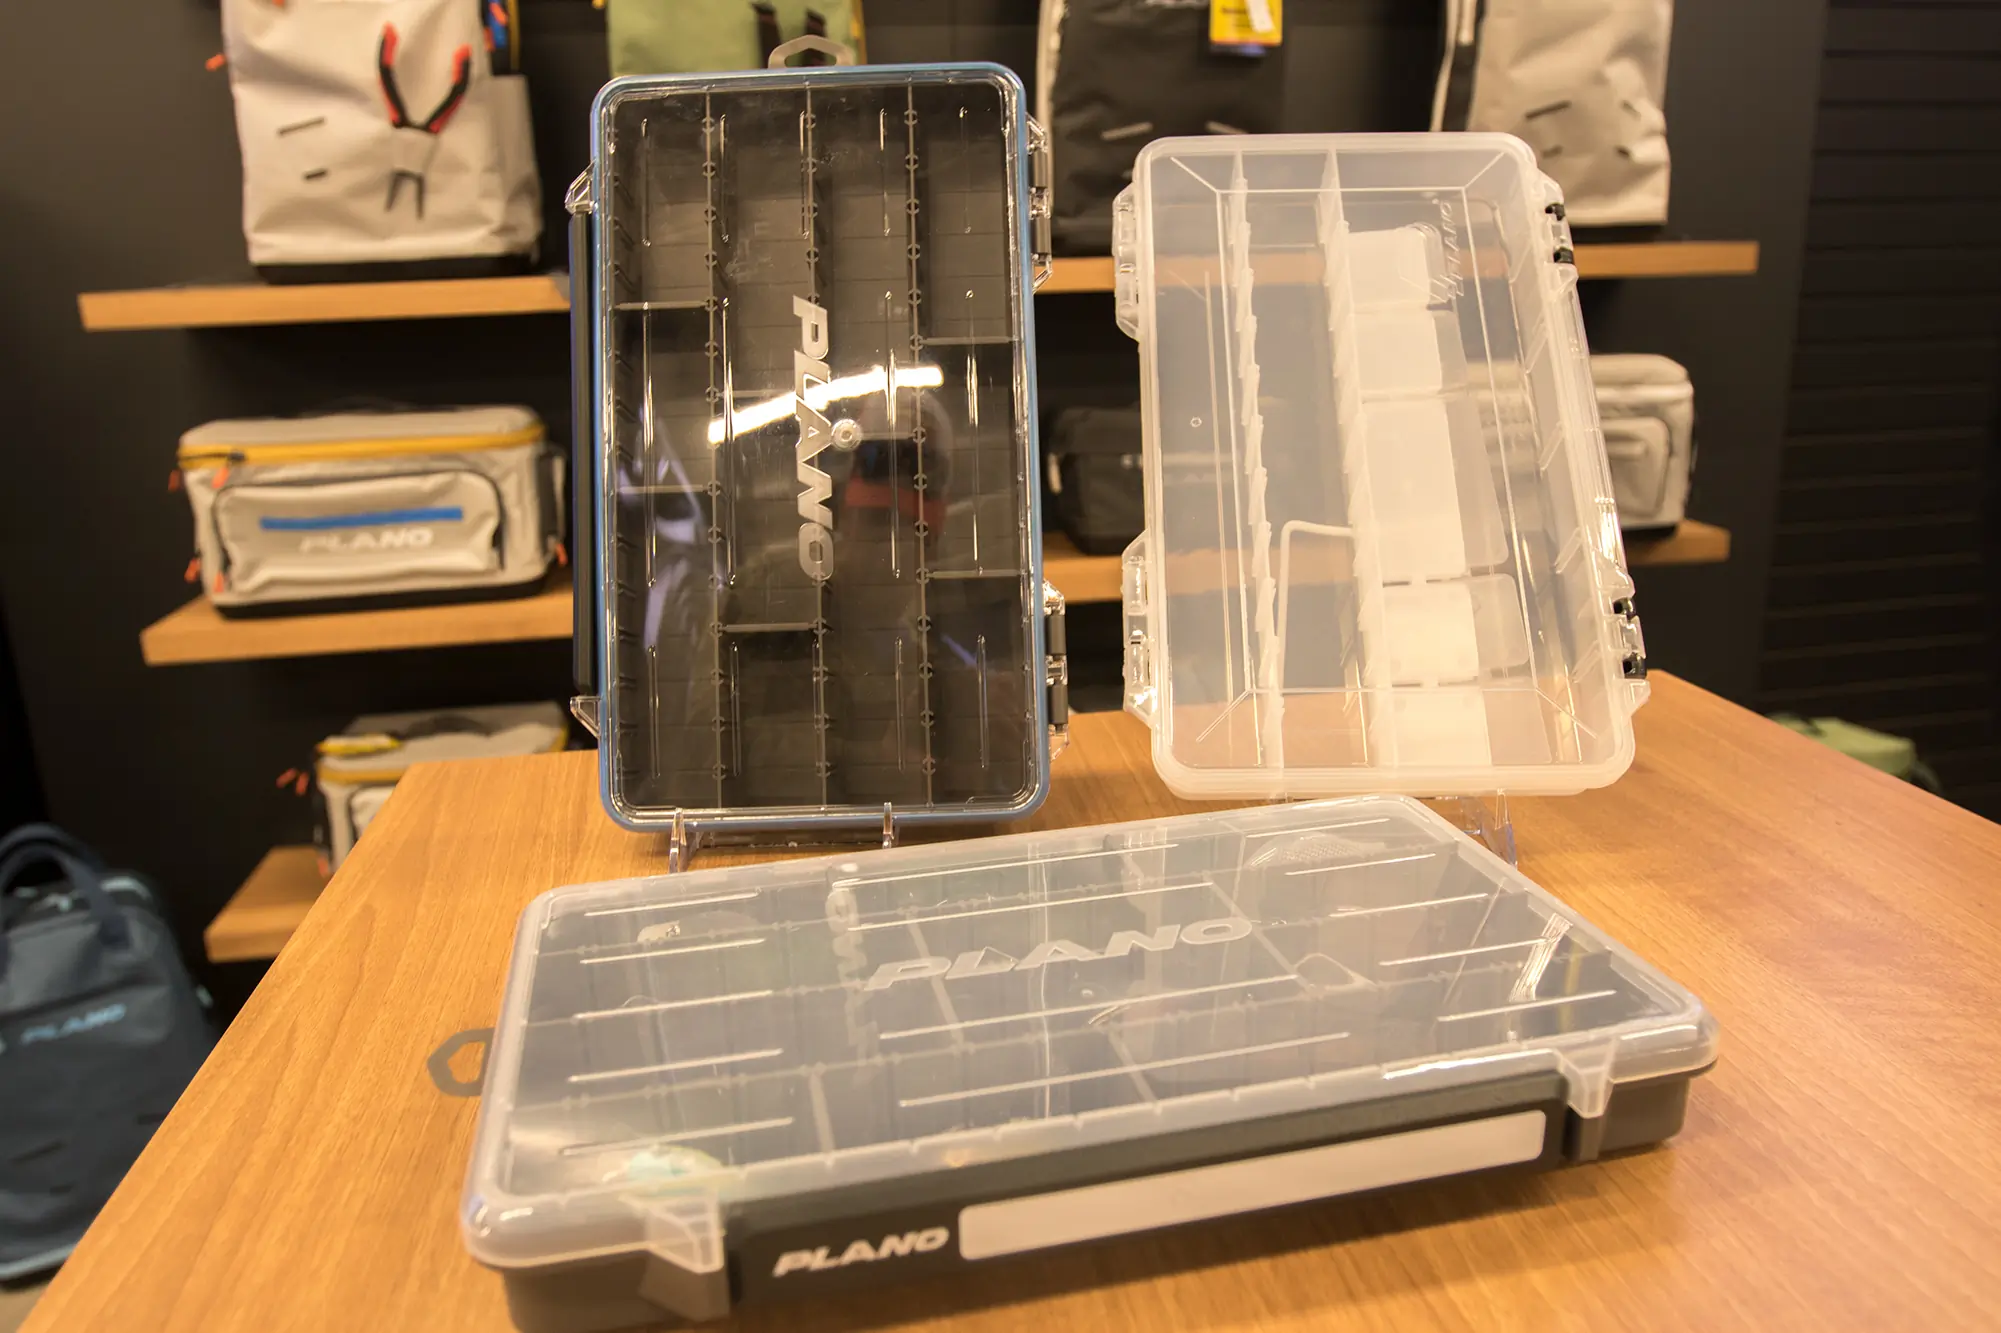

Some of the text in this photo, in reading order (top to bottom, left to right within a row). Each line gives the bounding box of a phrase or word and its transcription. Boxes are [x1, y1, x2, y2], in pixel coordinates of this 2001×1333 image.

[794, 296, 835, 581] PLANO
[299, 527, 434, 553] PLANO
[863, 917, 1253, 991] PLANO
[772, 1226, 950, 1278] PLANO
